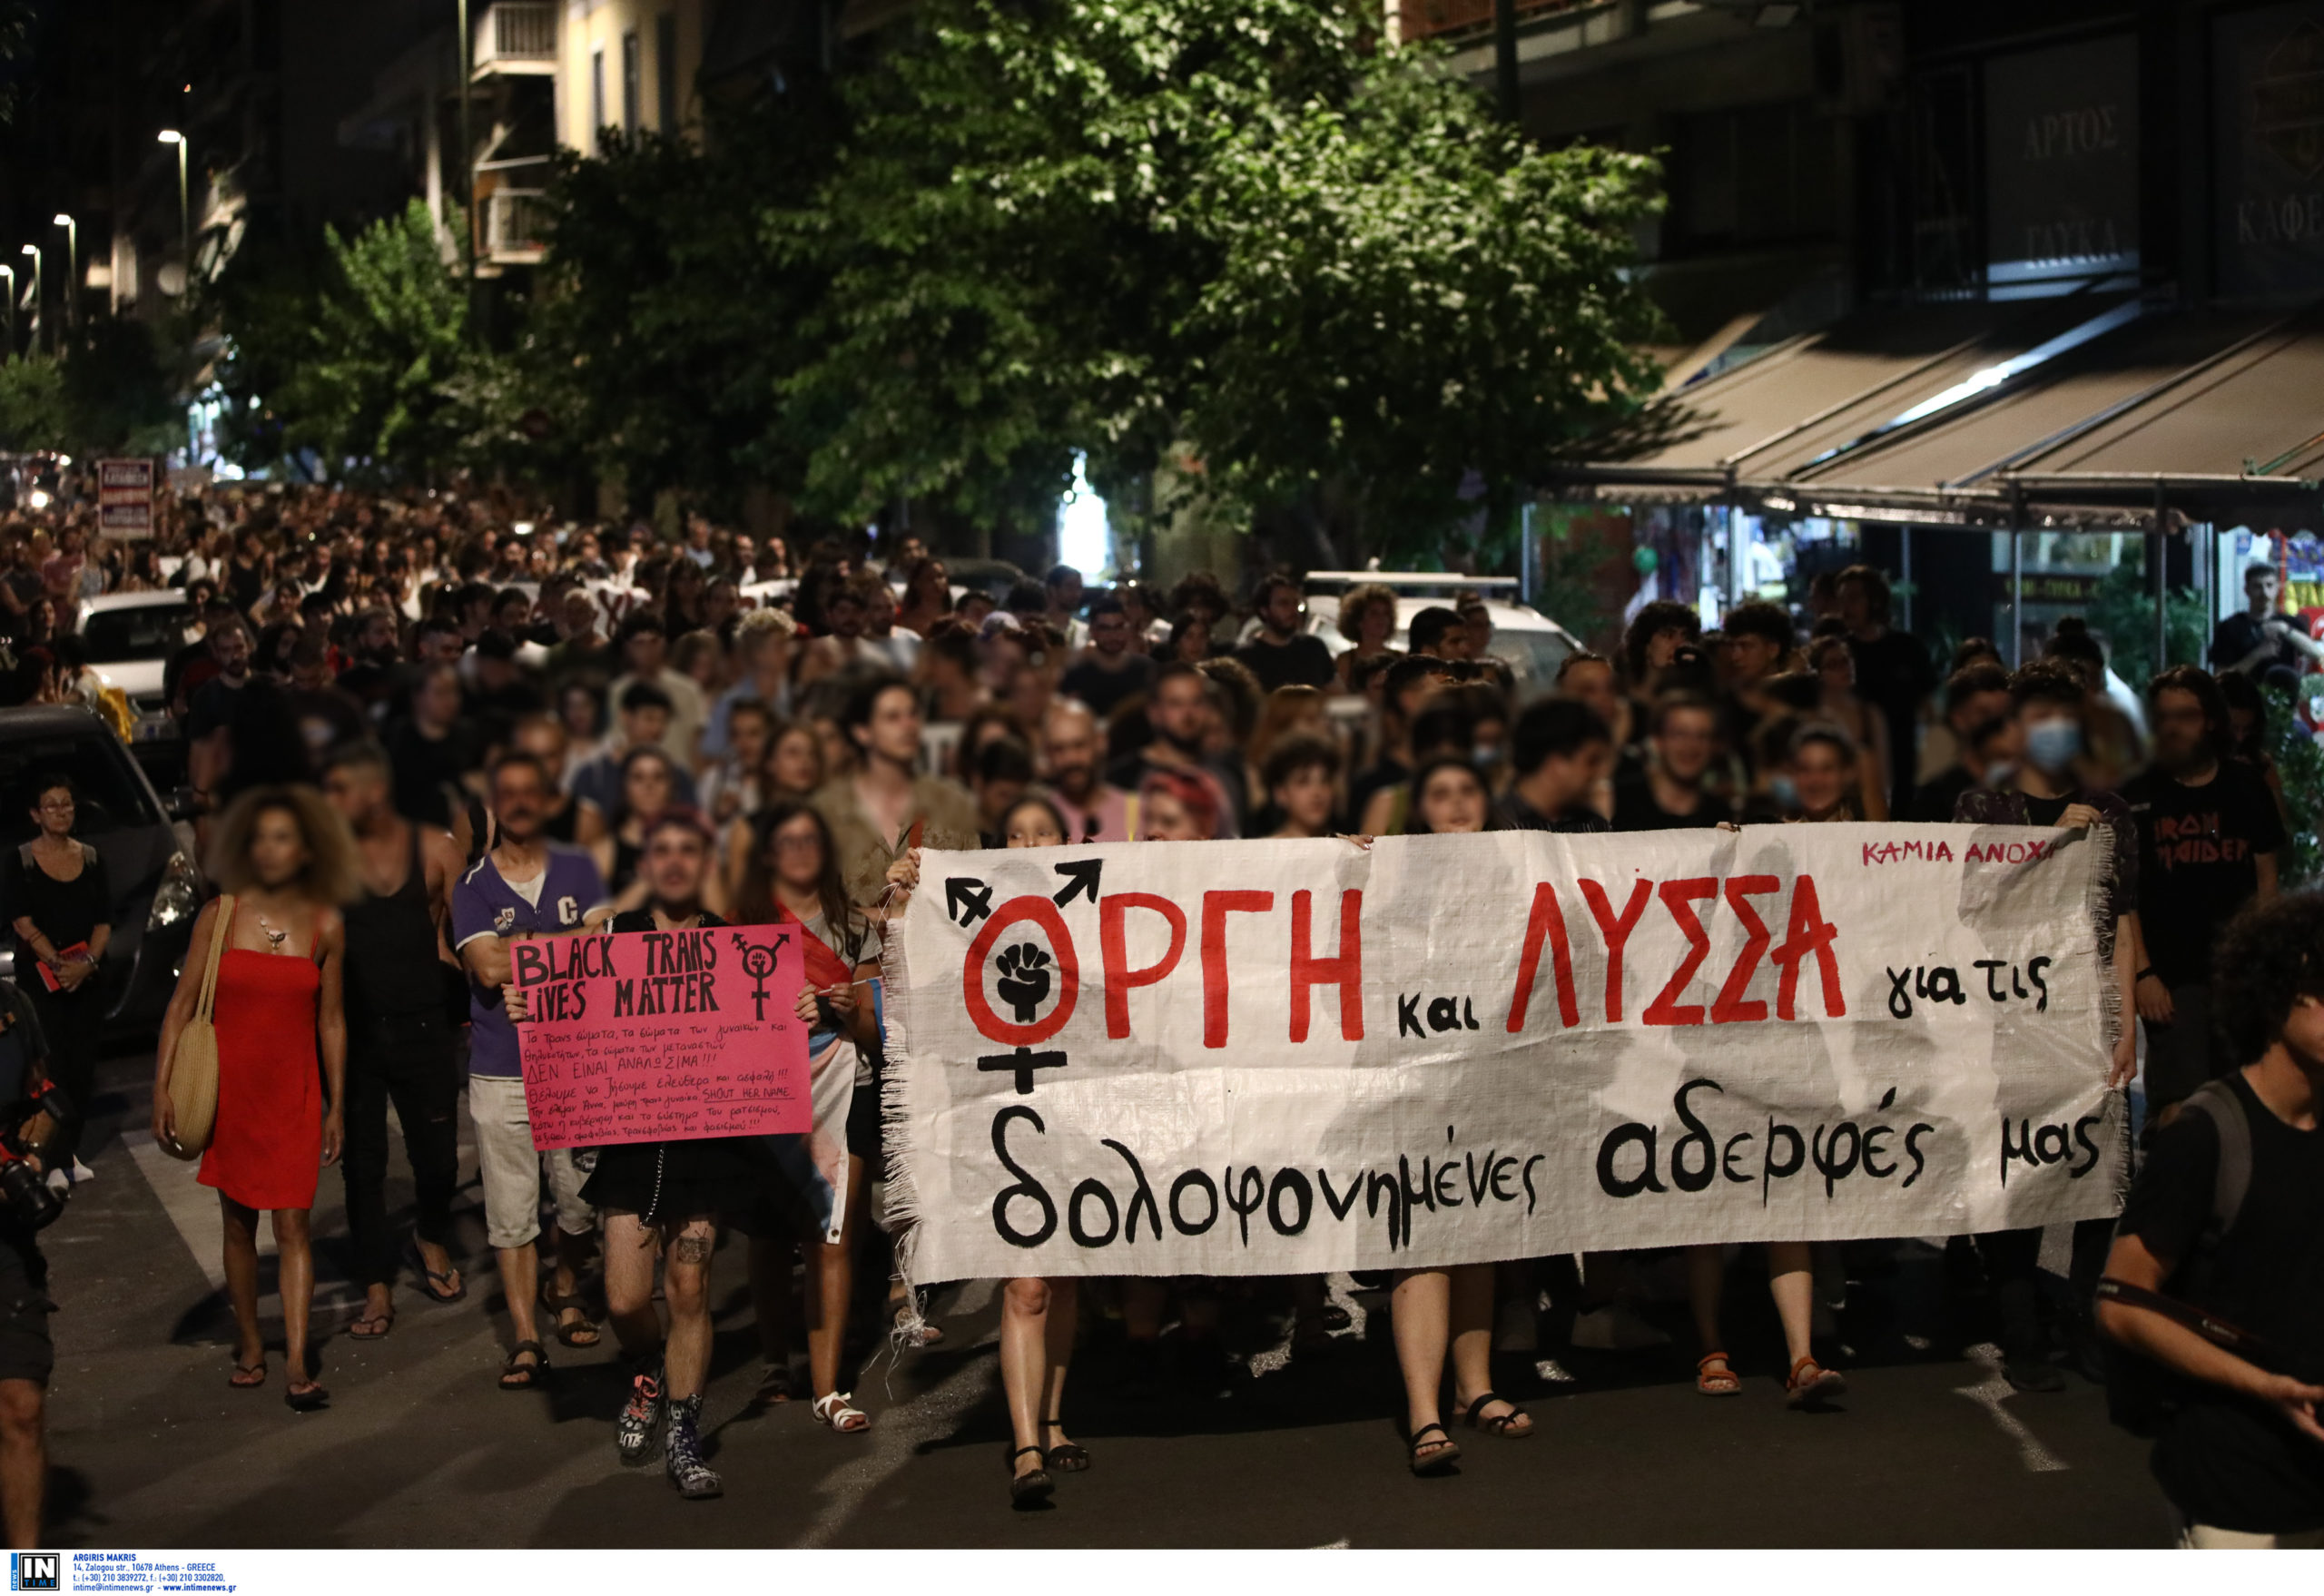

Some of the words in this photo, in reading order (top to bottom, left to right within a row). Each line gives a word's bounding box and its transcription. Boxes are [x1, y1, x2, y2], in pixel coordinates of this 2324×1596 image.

[2023, 105, 2118, 161] ΑΡΤΟΣ
[1861, 840, 1955, 868] ΚΑΜΙΑ
[515, 935, 616, 987] BLACK
[643, 931, 717, 976] TRANS
[963, 888, 1364, 1049] ΟΡΓΗ
[1398, 993, 1480, 1039] και
[1506, 874, 1846, 1033] ΛΥΣΣΑ
[1886, 966, 1966, 1020] για
[1973, 956, 2052, 1013] τις
[614, 971, 720, 1018] MATTER
[771, 1023, 787, 1032] και
[527, 1064, 558, 1085] ΔΕΝ
[573, 1059, 608, 1079] ΕΙΝΑΙ
[585, 1086, 598, 1095] να
[702, 1088, 734, 1100] SHOUT
[743, 1089, 760, 1098] HER
[763, 1087, 790, 1098] NAME
[991, 1105, 1546, 1252] δολοφονημένες
[1596, 1078, 1935, 1207] αδερφές
[2000, 1114, 2102, 1190] μας
